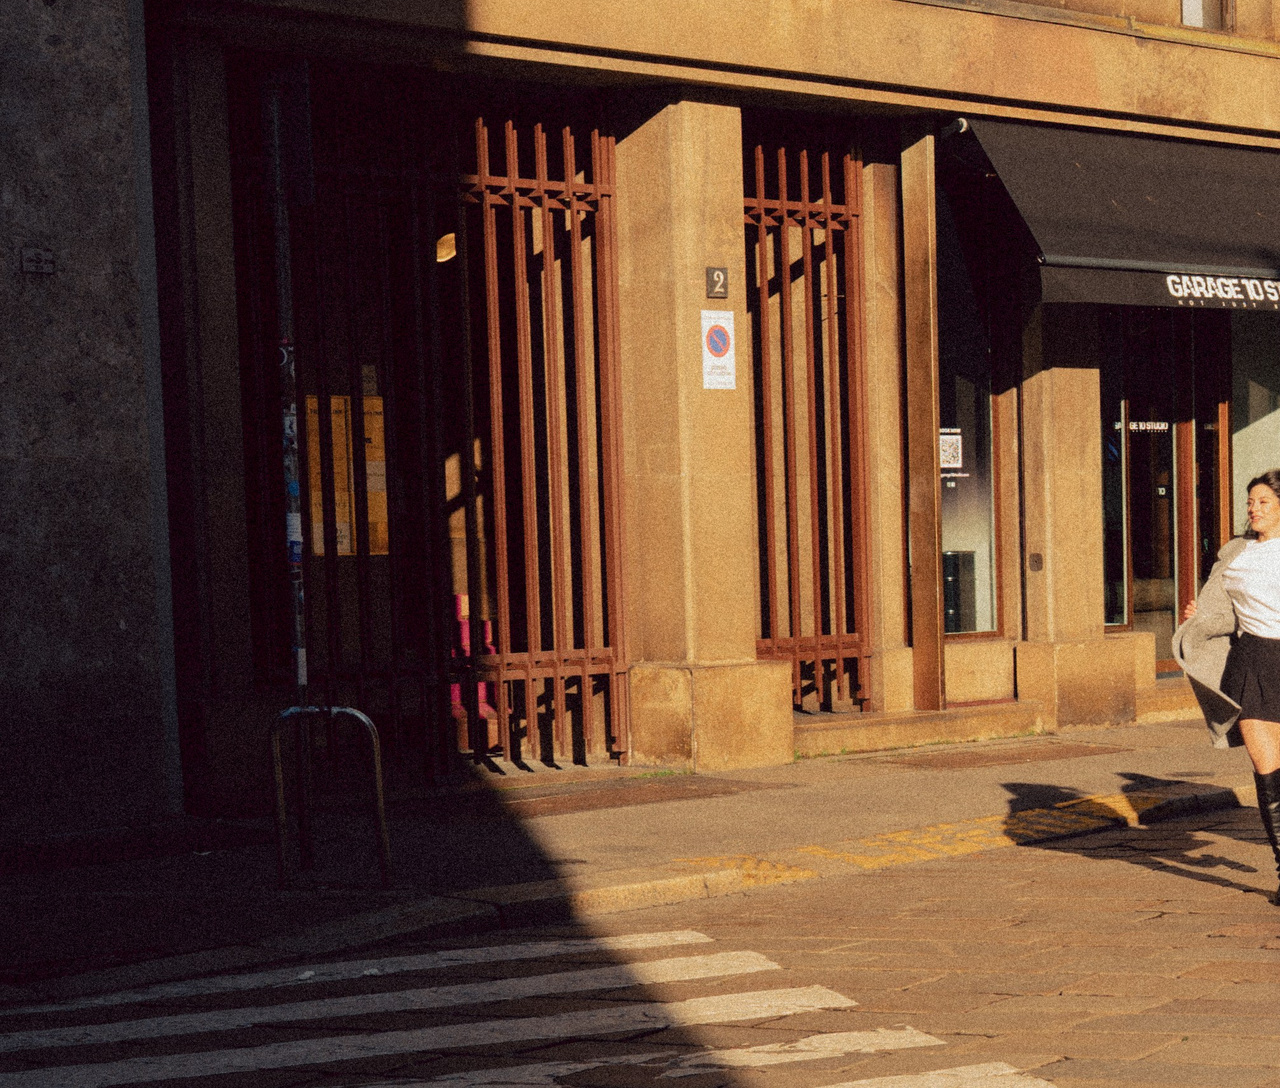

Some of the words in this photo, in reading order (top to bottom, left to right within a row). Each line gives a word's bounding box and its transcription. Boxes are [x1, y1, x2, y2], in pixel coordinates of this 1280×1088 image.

[713, 270, 725, 293] 2
[1166, 275, 1245, 299] GARAGE
[1241, 278, 1265, 301] 10
